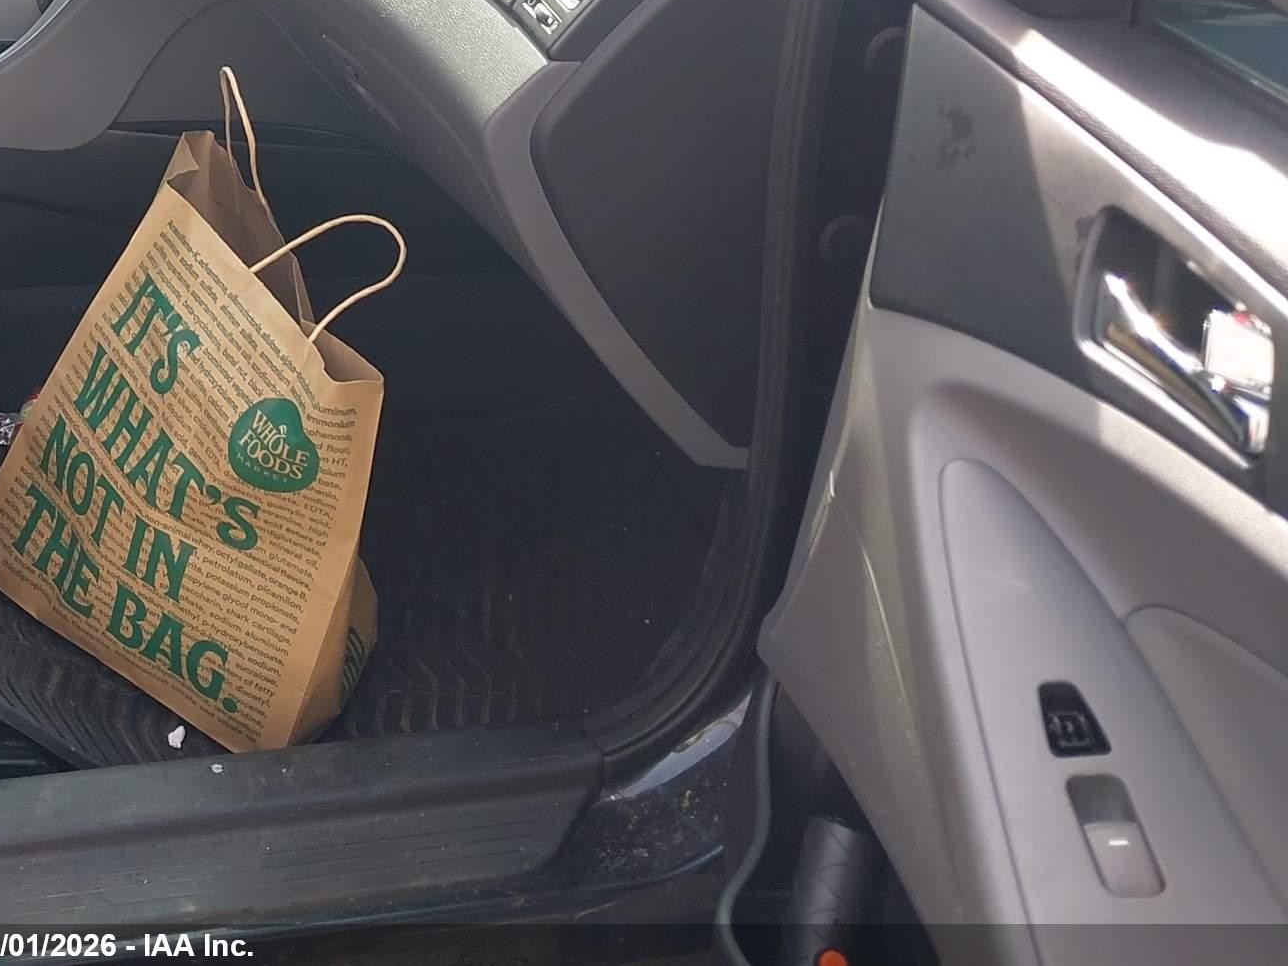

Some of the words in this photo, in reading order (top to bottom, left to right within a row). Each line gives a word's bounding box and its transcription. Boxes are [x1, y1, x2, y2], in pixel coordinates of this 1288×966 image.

[238, 429, 304, 480] FOODS
[252, 409, 310, 467] WHOLE
[41, 414, 124, 546] NOT
[120, 518, 198, 602] IN
[307, 524, 330, 539] high
[315, 538, 326, 547] of
[267, 539, 303, 561] mineral
[303, 557, 320, 570] oil,
[267, 551, 317, 581] glutamate,
[12, 484, 100, 618] THE
[105, 591, 239, 714] BAG.
[200, 554, 257, 588] petrolatum,
[255, 582, 306, 613] picamilon,
[204, 569, 251, 598] potassium
[249, 592, 302, 624] propionate,
[267, 576, 300, 598] orange
[208, 609, 243, 632] sodium
[244, 628, 289, 657] aluminum
[220, 591, 250, 611] glycol
[248, 606, 279, 625] mono-
[278, 621, 297, 635] and
[225, 606, 251, 623] shark
[249, 619, 294, 647] cartilage,
[234, 660, 279, 688] sucralose,
